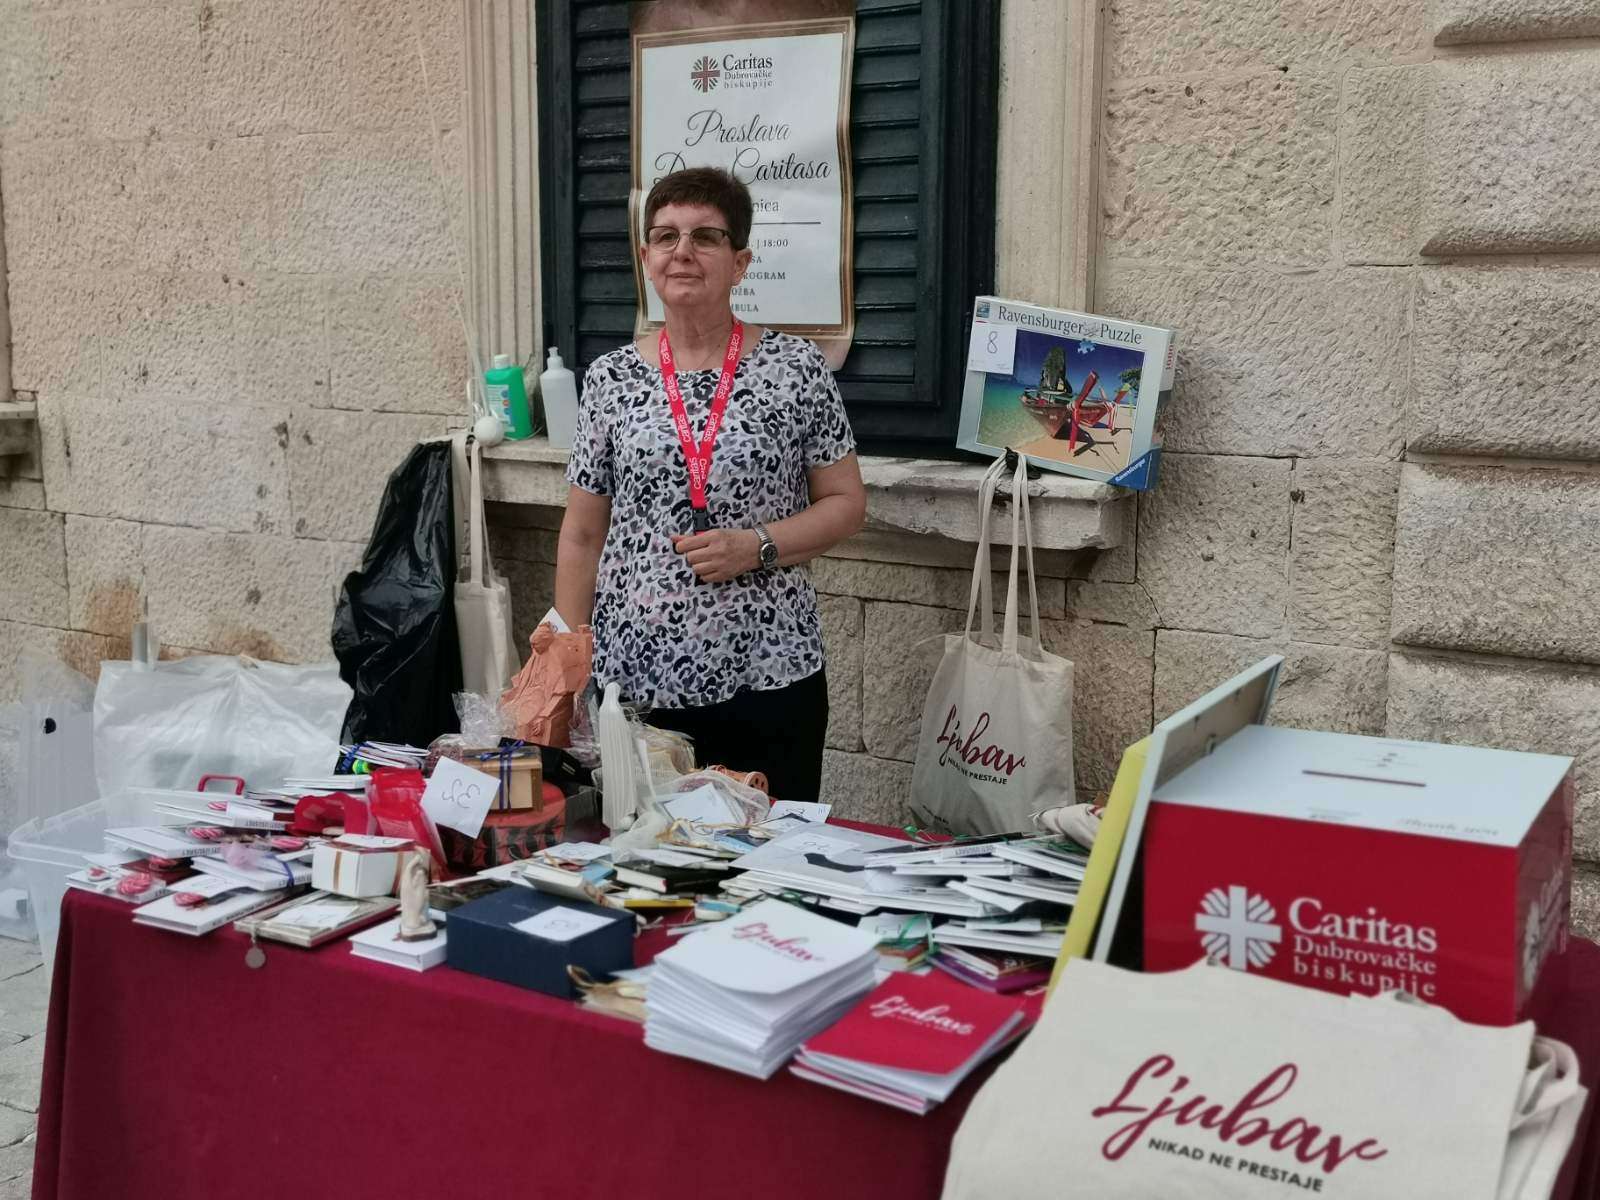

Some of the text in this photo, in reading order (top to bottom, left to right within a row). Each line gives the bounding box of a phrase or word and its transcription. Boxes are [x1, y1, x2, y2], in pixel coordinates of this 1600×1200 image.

[723, 52, 773, 71] Caritas
[685, 109, 791, 147] Proslava
[752, 200, 779, 213] nica
[763, 239, 789, 248] 18:00
[751, 255, 763, 264] SA
[743, 271, 786, 280] ROGRAM
[731, 285, 756, 296] OŽBA
[731, 303, 759, 312] BULA
[998, 306, 1142, 345] Ravensburger Puzzle
[728, 333, 741, 361] caritas
[986, 331, 999, 354] 8
[717, 371, 731, 400] caritas
[677, 413, 692, 443] caritas
[703, 412, 719, 443] caritas
[969, 771, 1008, 785] PRESTAJE
[1289, 897, 1438, 953] Caritas
[1294, 934, 1437, 975] Dubrovačke
[1294, 956, 1437, 997] biskupije
[1092, 1053, 1389, 1175] Ljubav
[1148, 1138, 1324, 1193] NIKAD NE PRESTAJE
